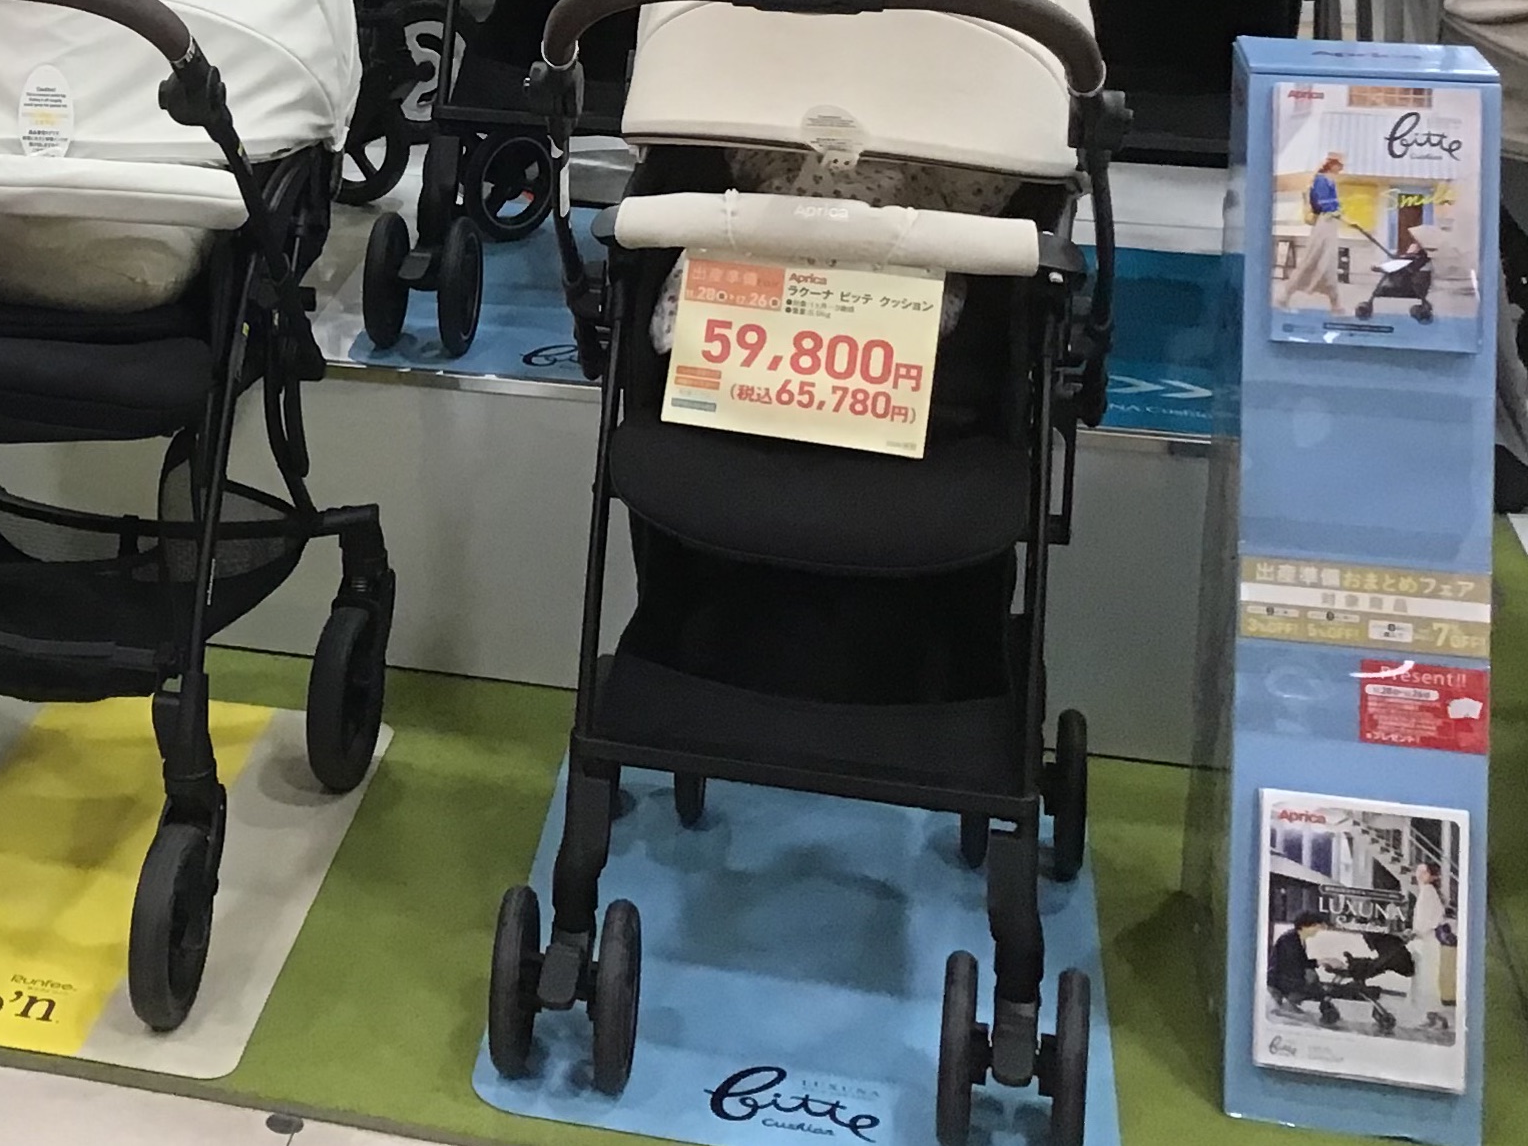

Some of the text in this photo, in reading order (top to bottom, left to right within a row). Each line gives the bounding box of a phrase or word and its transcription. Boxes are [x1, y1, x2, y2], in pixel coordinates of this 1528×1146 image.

[1287, 89, 1325, 101] Aprica
[794, 204, 849, 220] Aprica
[789, 272, 828, 285] Aprica
[787, 285, 934, 312] ラクーナ ビッテ クッション
[700, 318, 923, 393] 59,800円
[1255, 562, 1475, 598] 出産準備おまとめフェア
[1277, 808, 1327, 825] Aprica
[1318, 894, 1407, 922] LUXUNA
